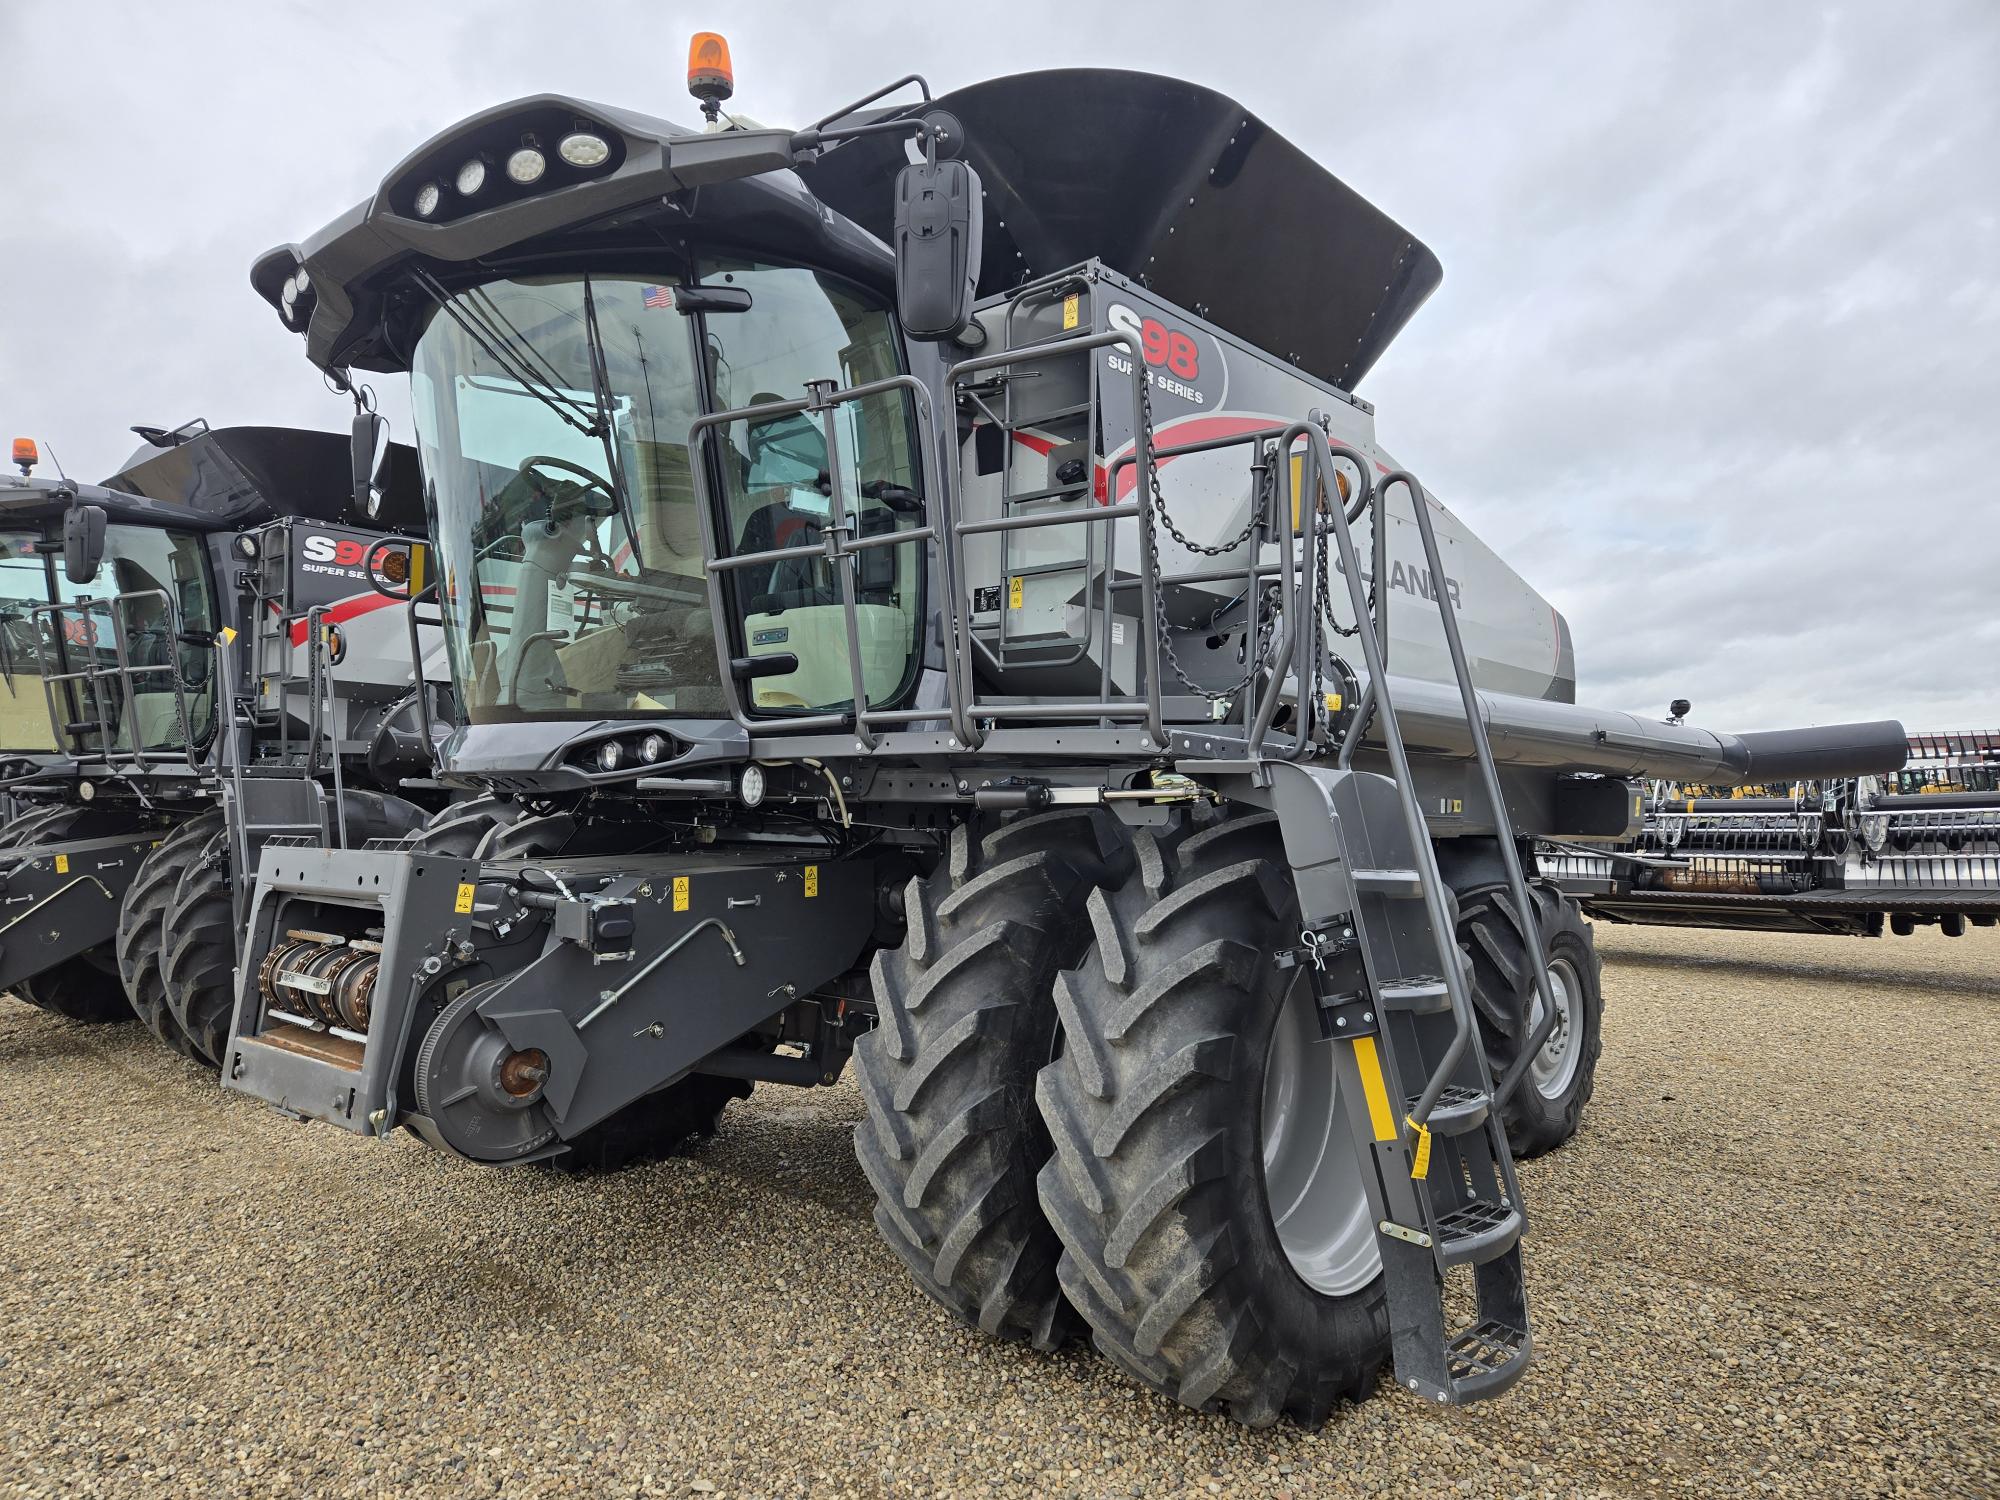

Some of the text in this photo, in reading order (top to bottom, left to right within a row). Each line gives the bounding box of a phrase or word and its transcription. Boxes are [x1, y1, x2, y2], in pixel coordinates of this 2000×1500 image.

[1107, 303, 1198, 380] S98
[1107, 355, 1204, 404] SUPR SERIES
[302, 563, 345, 577] SUPER
